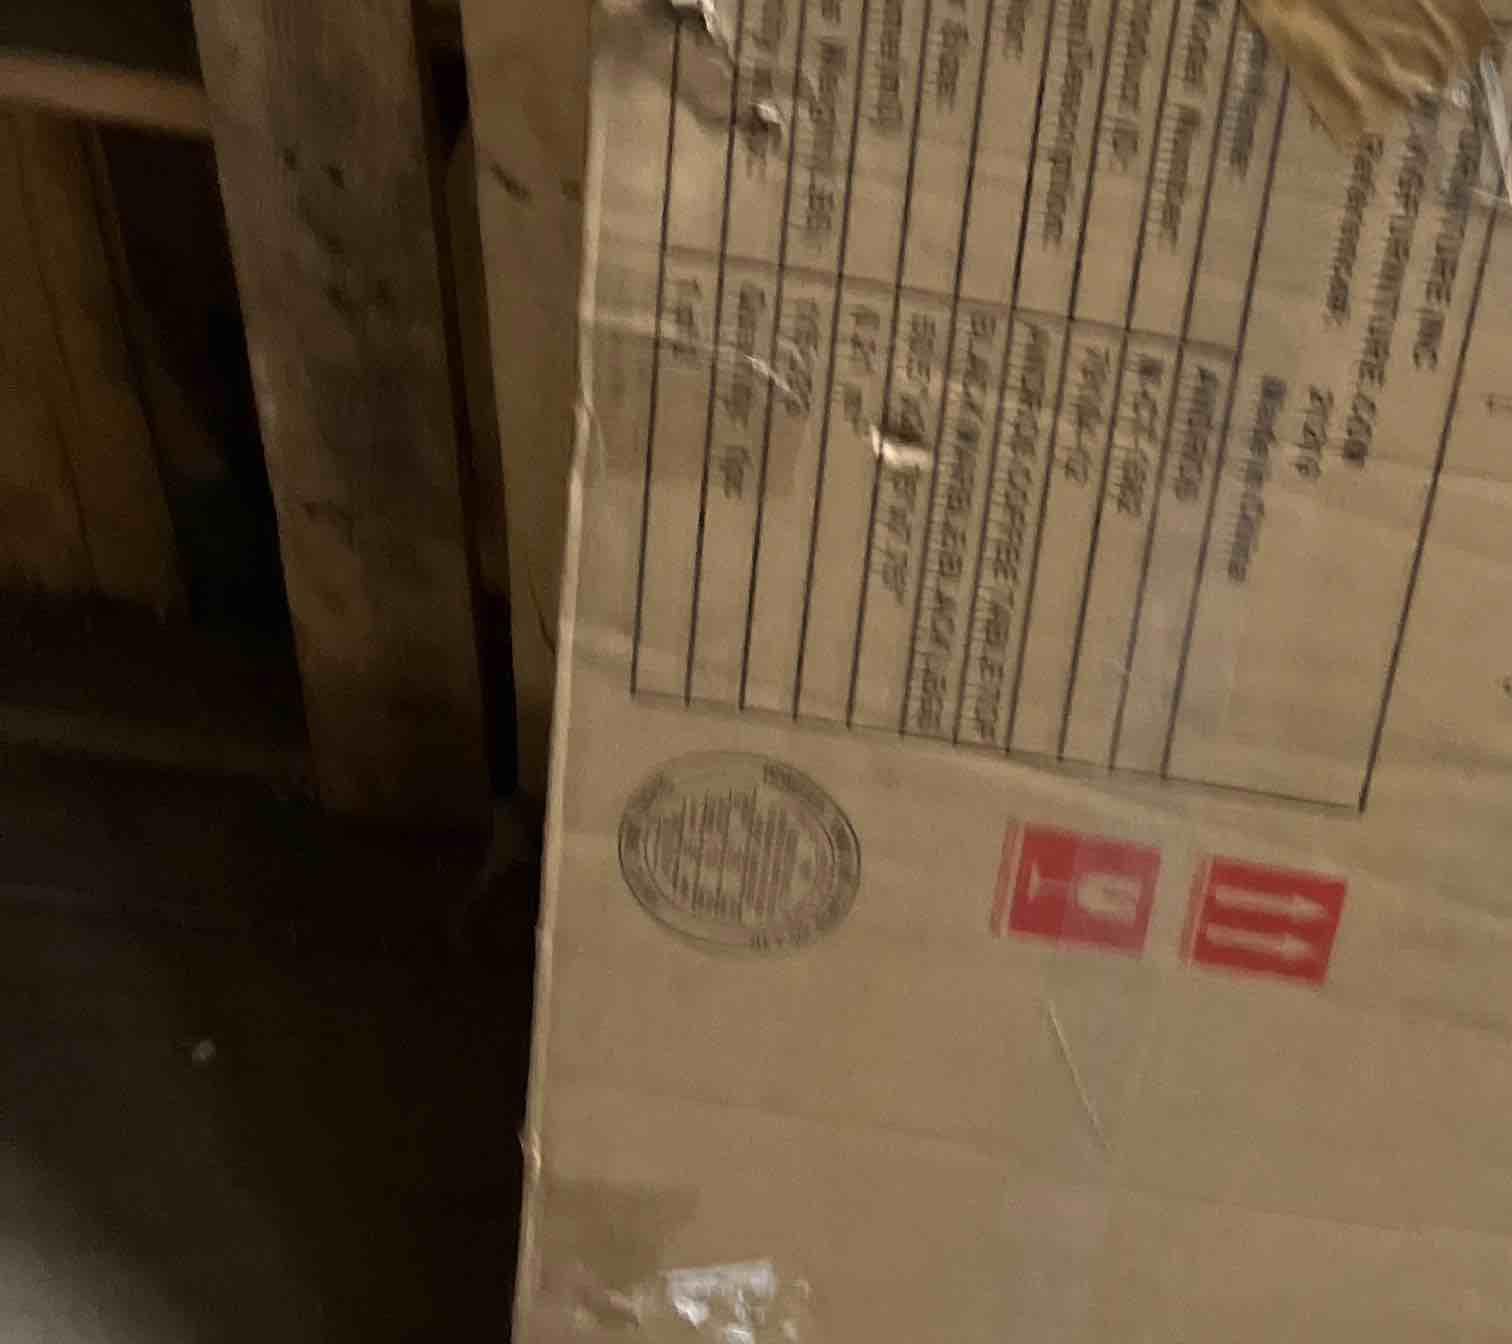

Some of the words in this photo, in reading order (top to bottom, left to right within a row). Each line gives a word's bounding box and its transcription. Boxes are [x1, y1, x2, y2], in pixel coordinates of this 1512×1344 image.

[959, 314, 997, 416] BLACK
[1250, 375, 1289, 456] Made
[994, 458, 1036, 583] COFFEE
[1228, 490, 1267, 585] China
[981, 587, 1016, 681] TABLE
